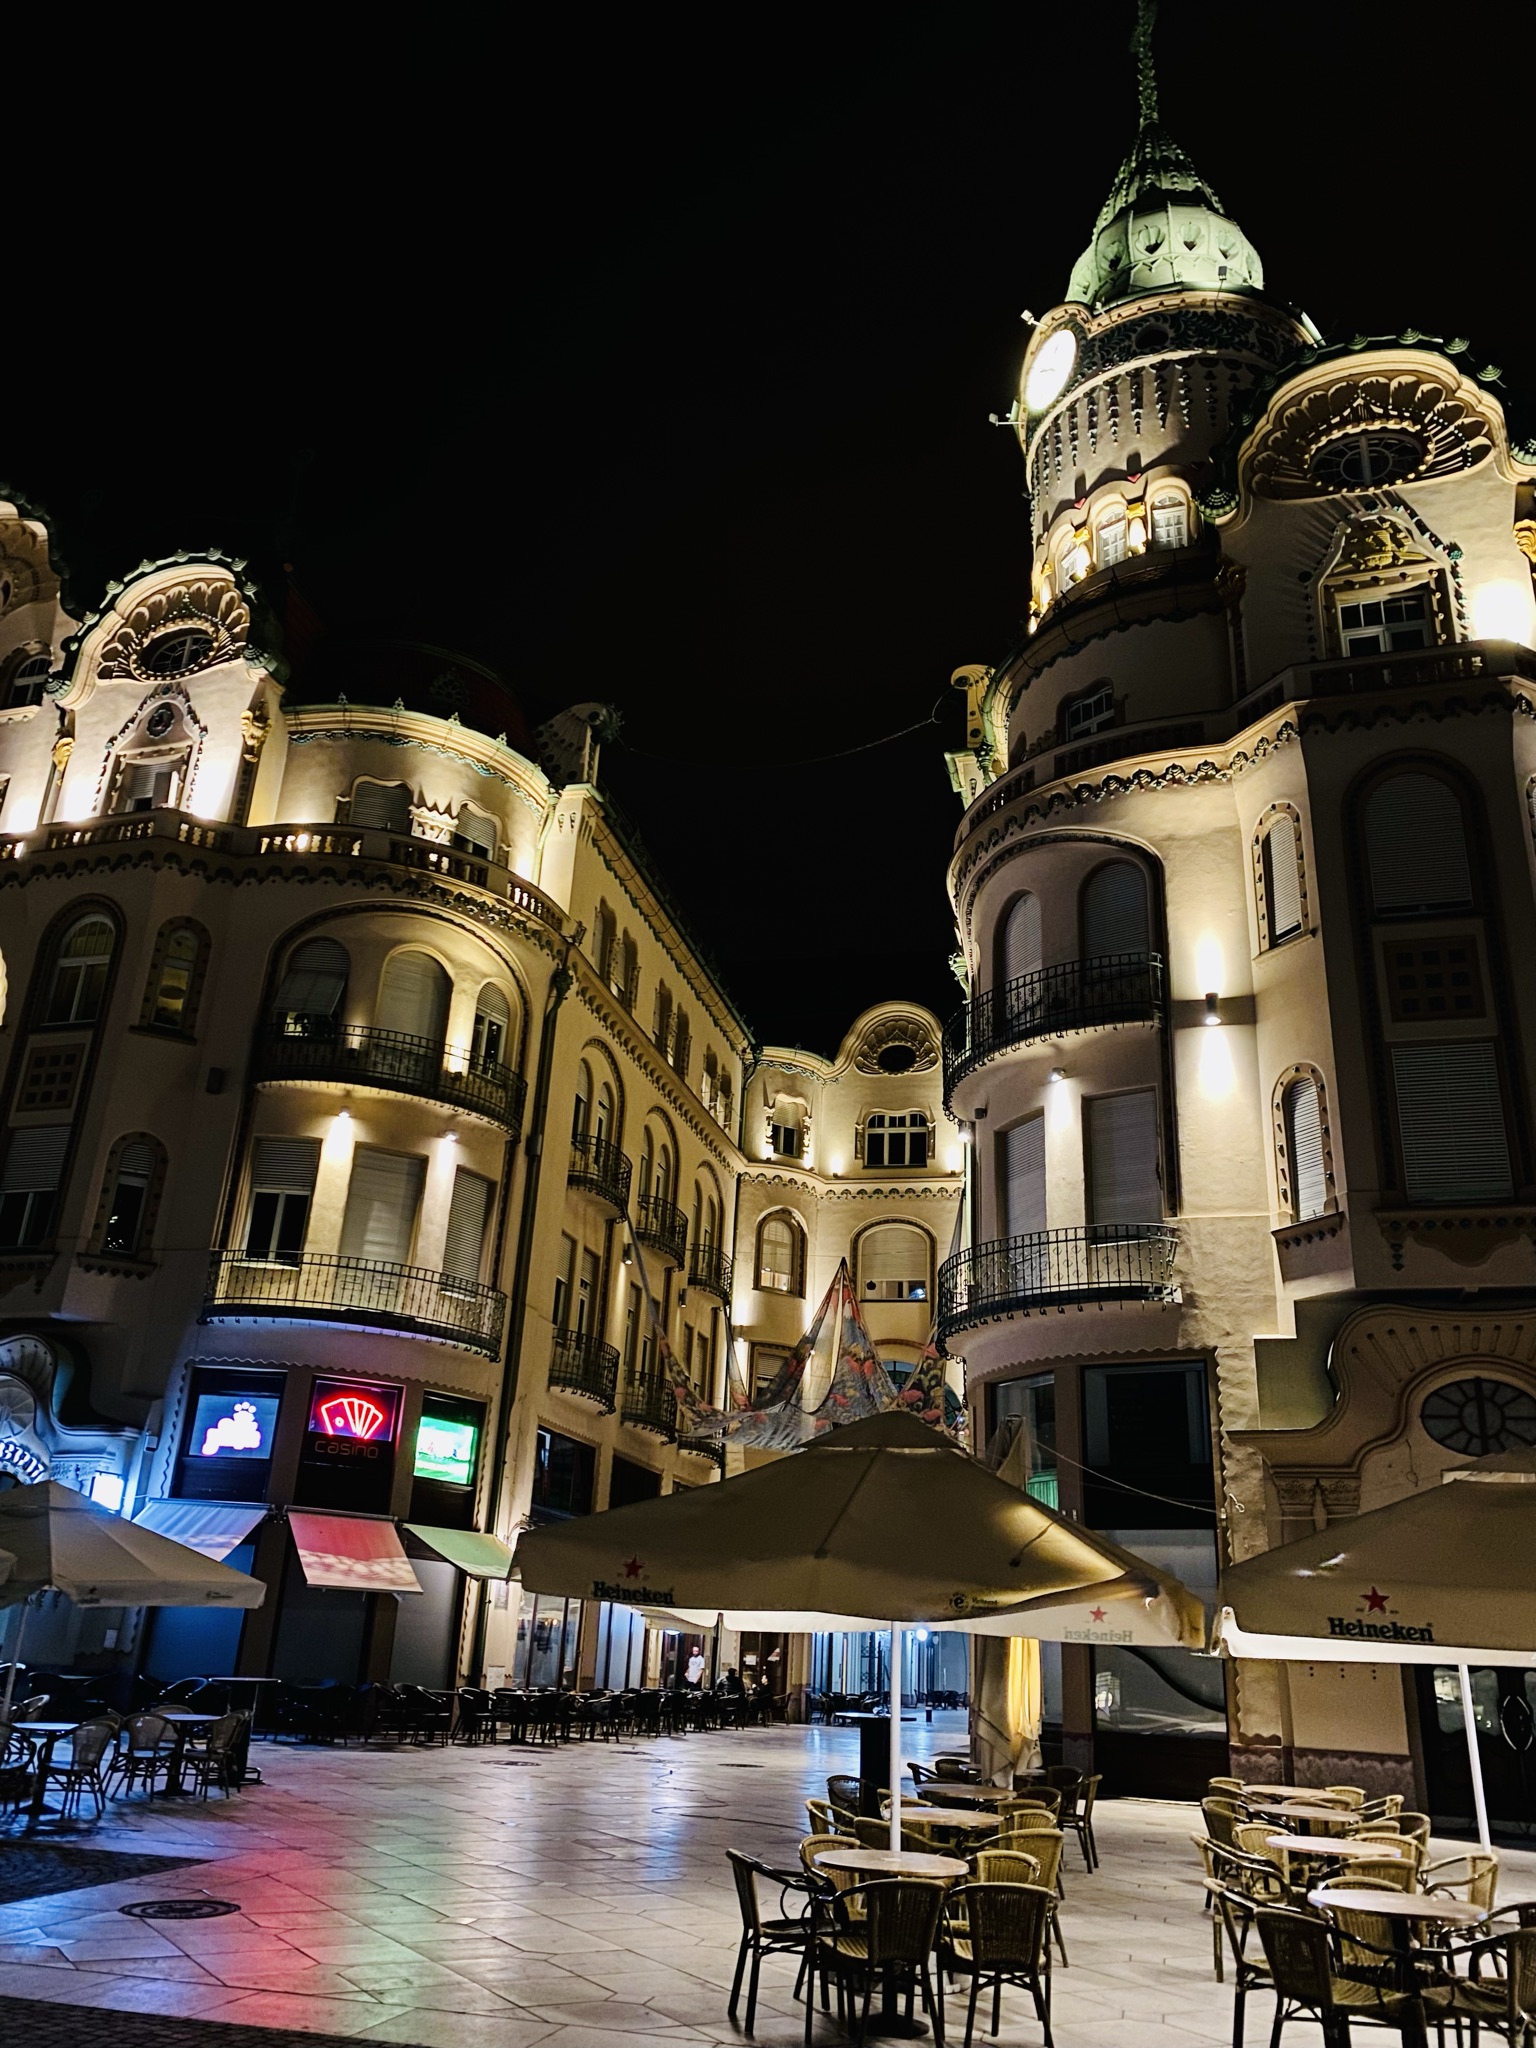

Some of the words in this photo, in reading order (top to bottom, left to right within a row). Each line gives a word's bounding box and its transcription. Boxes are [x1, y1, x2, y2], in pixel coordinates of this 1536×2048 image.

[316, 1441, 378, 1458] casino
[592, 1581, 675, 1604] Heineken
[1328, 1618, 1435, 1642] Heineken
